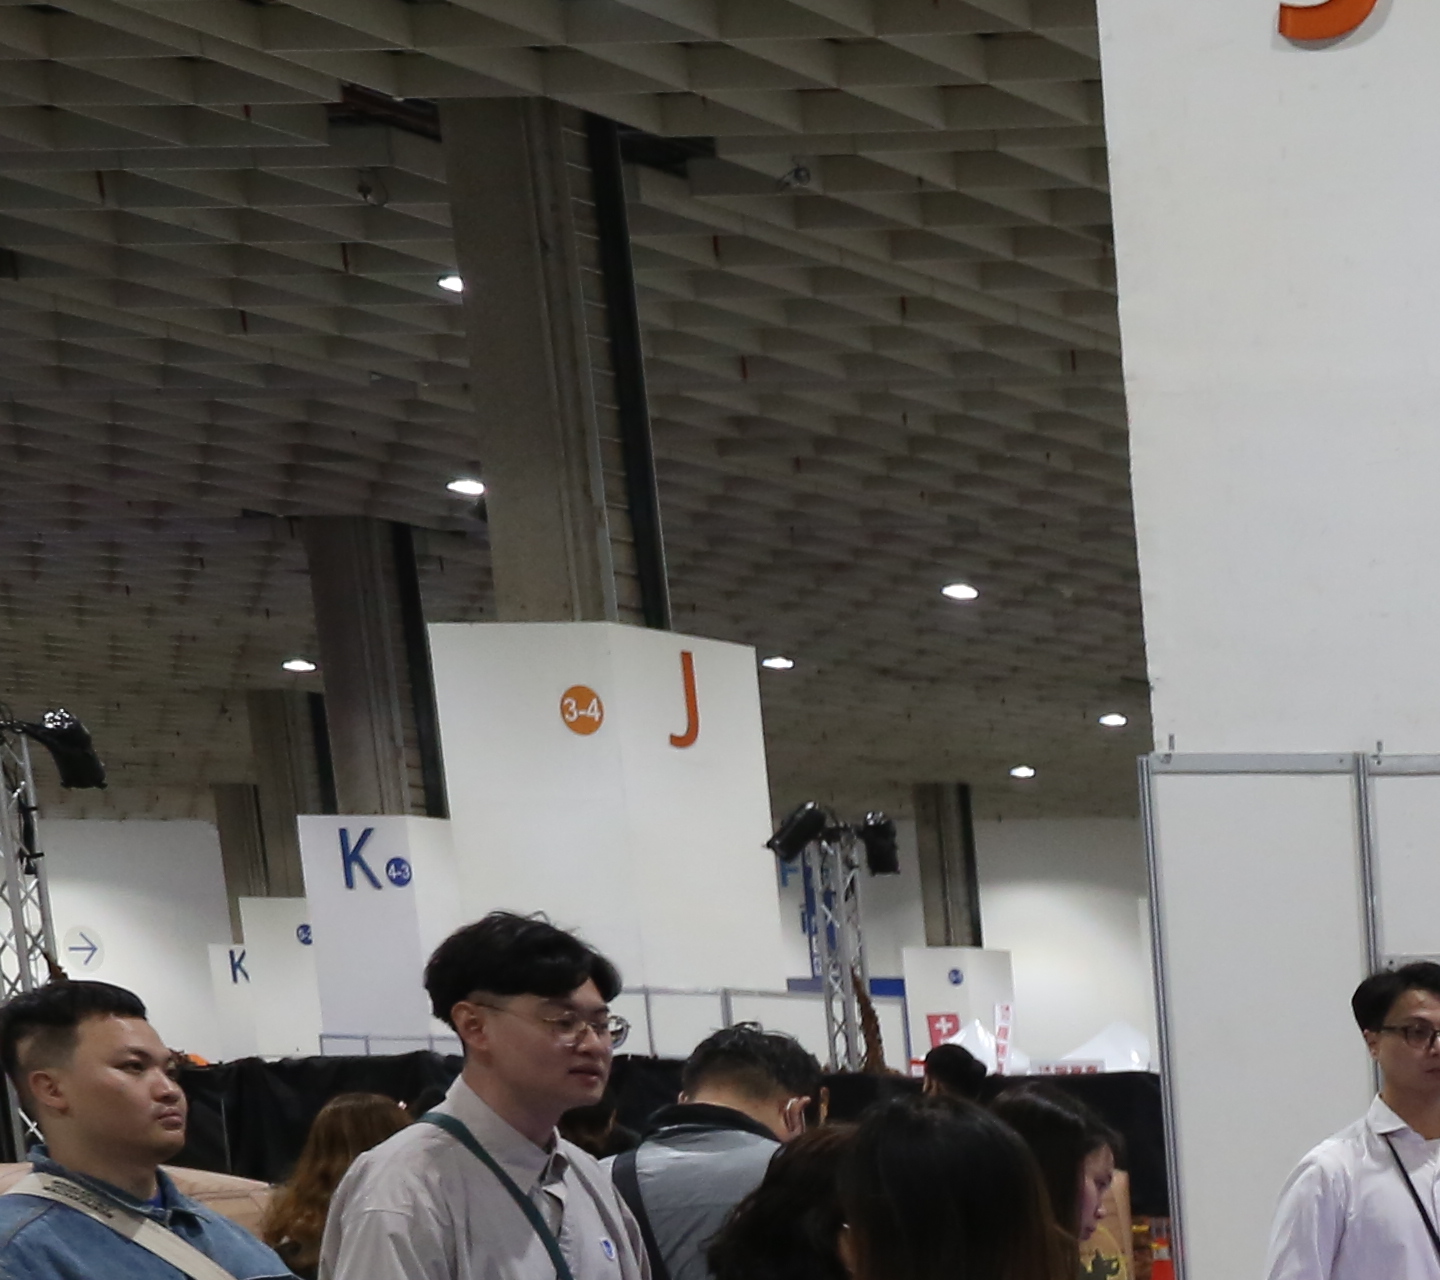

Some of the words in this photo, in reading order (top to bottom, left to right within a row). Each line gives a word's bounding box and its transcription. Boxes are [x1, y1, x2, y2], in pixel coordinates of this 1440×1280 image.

[562, 698, 602, 722] 3-4
[669, 650, 700, 748] J
[338, 827, 383, 890] K
[388, 862, 411, 880] 4-3
[229, 949, 250, 984] K
